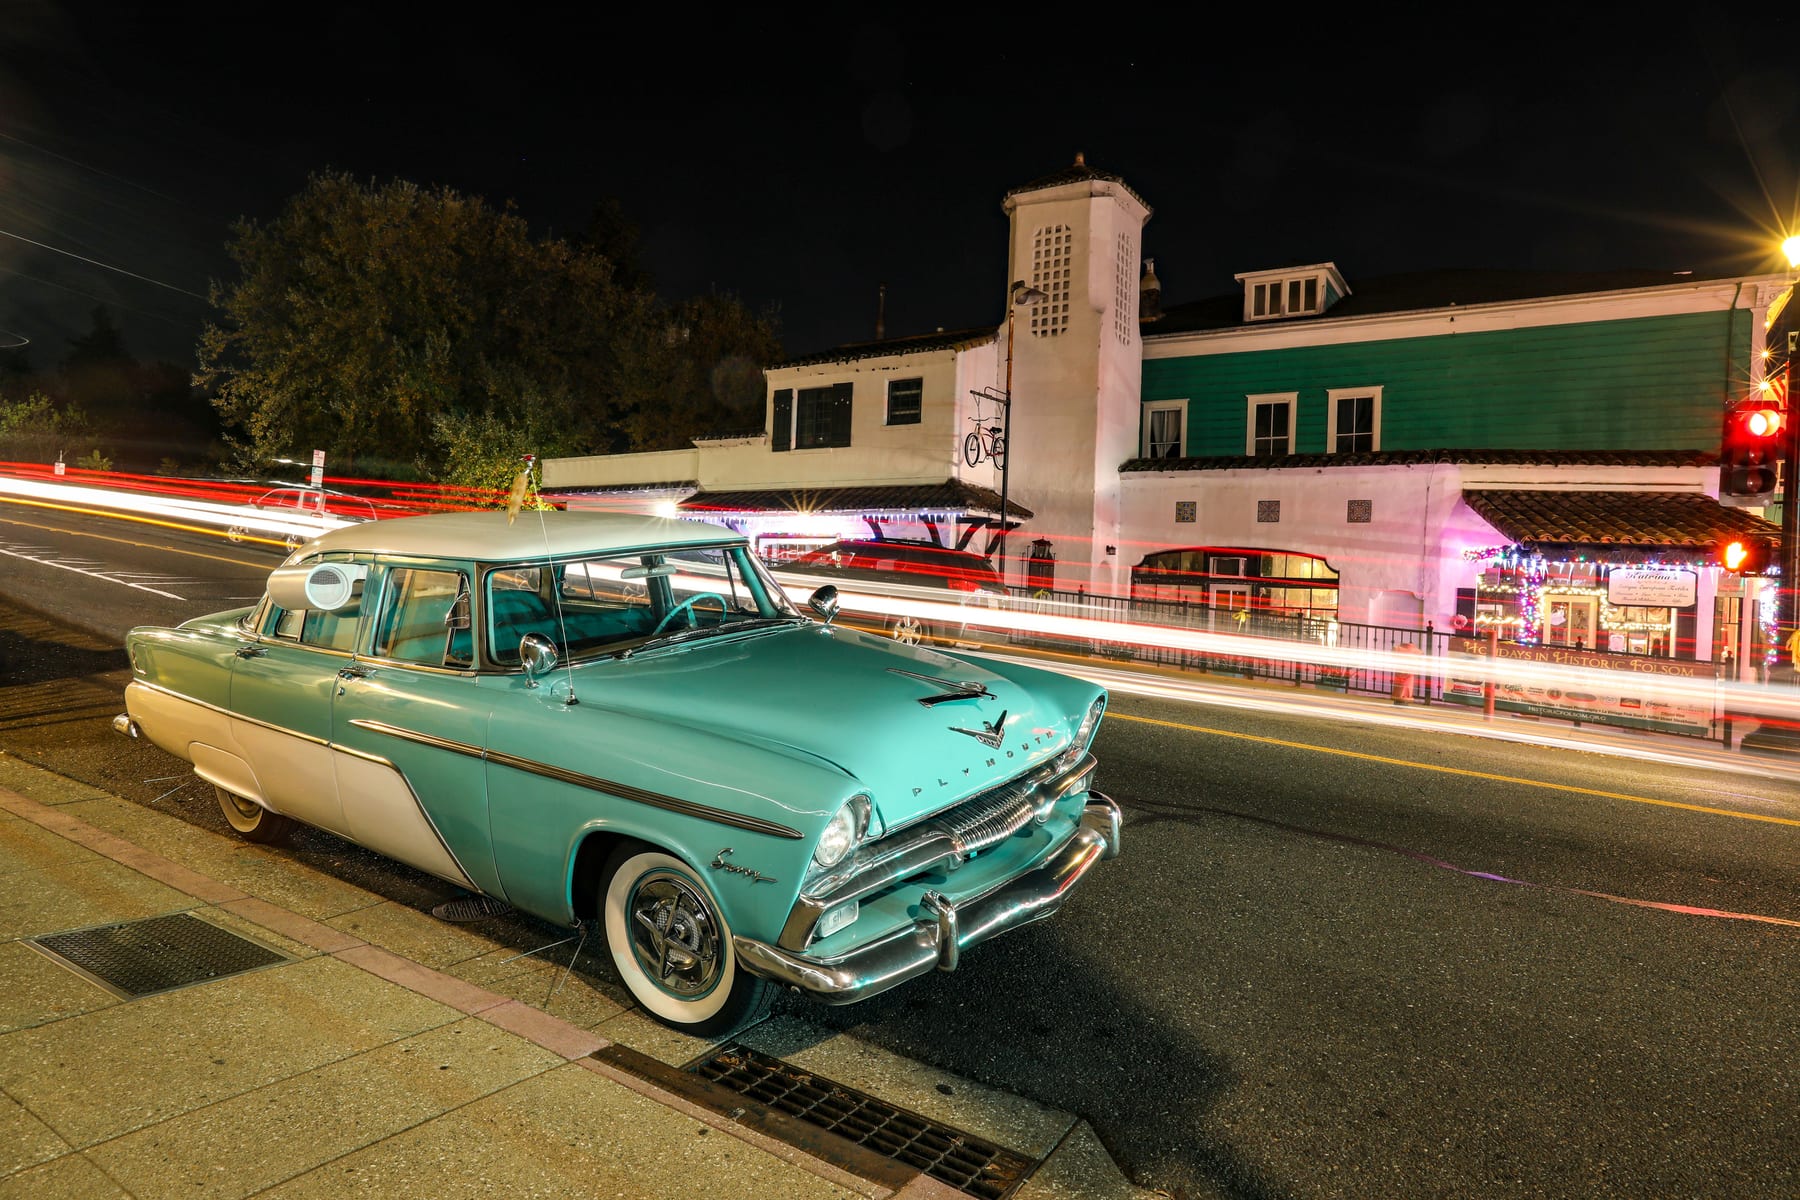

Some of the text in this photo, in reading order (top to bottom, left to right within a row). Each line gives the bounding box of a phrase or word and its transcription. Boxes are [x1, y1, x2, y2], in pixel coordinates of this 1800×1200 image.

[1535, 652, 1549, 662] IN
[1552, 651, 1625, 670] HISTORIC
[1630, 659, 1695, 677] FOLSOM
[911, 730, 1054, 797] PLYMOUTH
